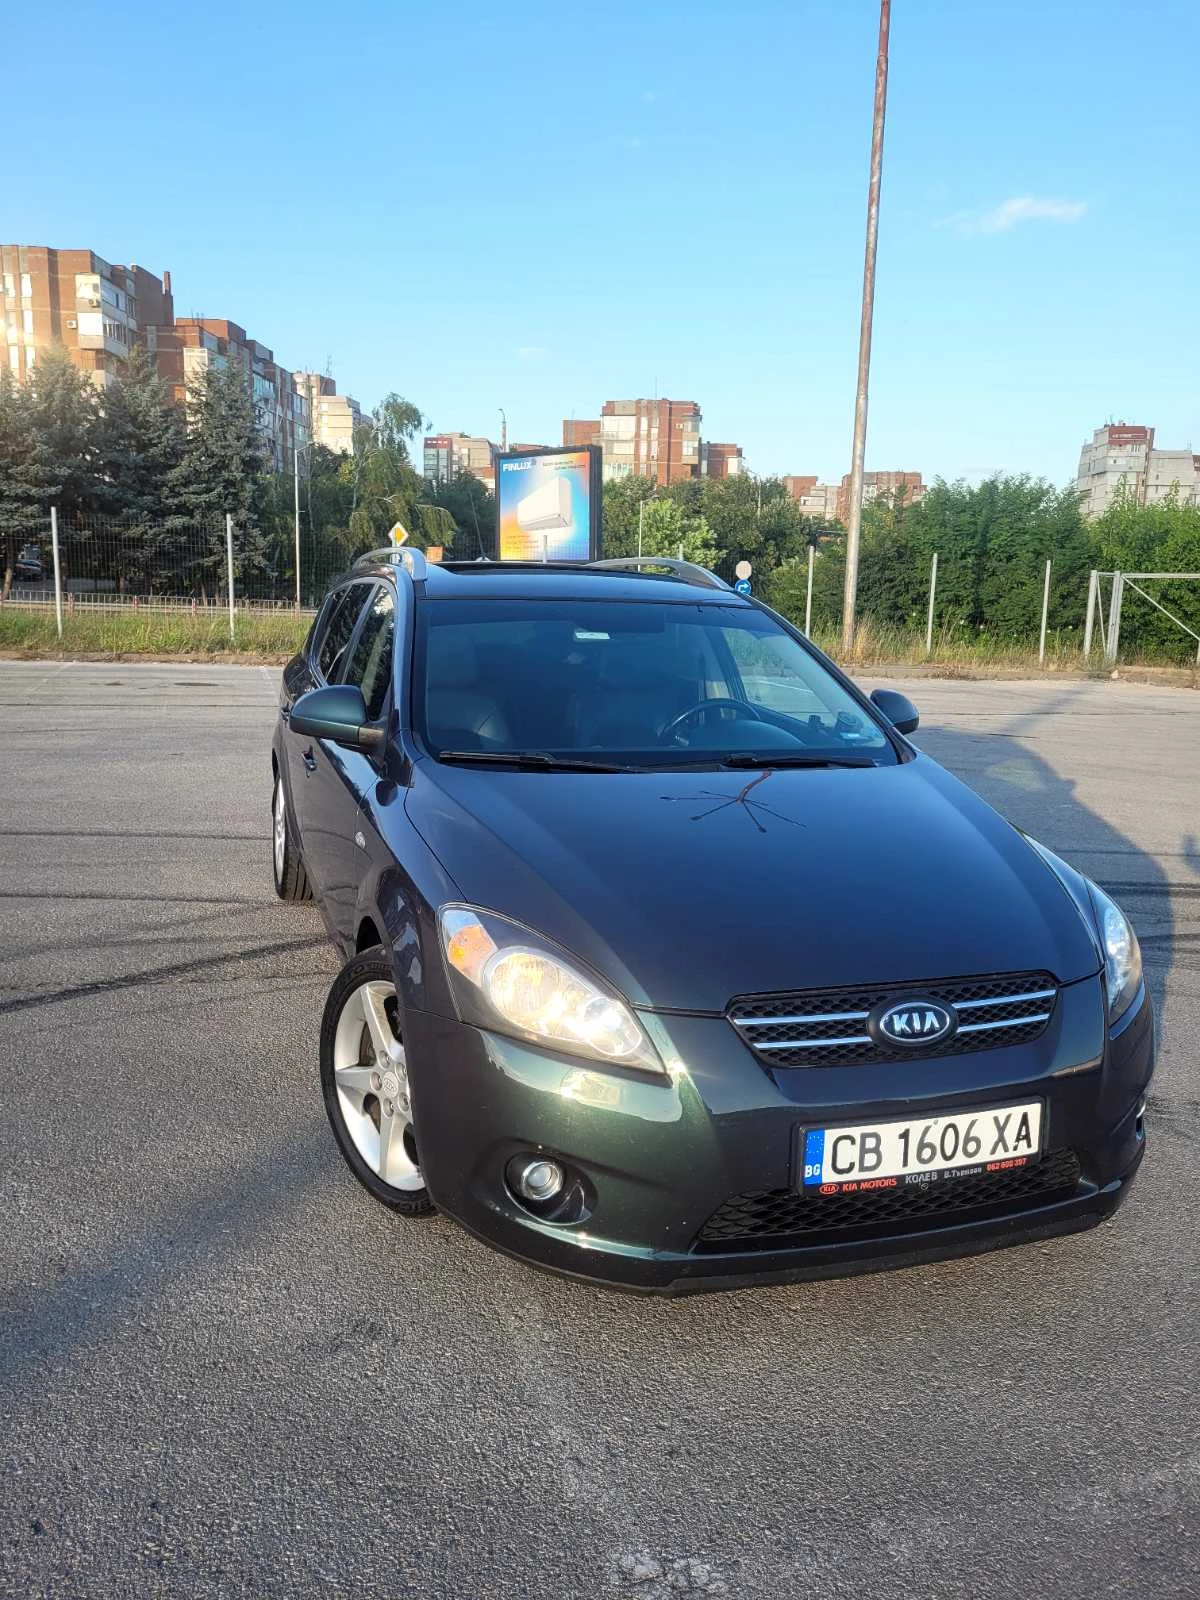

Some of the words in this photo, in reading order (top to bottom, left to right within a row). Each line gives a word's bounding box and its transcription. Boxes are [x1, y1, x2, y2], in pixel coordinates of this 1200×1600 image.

[502, 461, 531, 473] FINLUX
[892, 1011, 940, 1035] KIA
[898, 1119, 982, 1168] 1606
[804, 1164, 821, 1178] BG
[905, 1171, 938, 1184] КОЛЕВ
[843, 1183, 857, 1192] KIA
[860, 1178, 897, 1190] MOTORS
